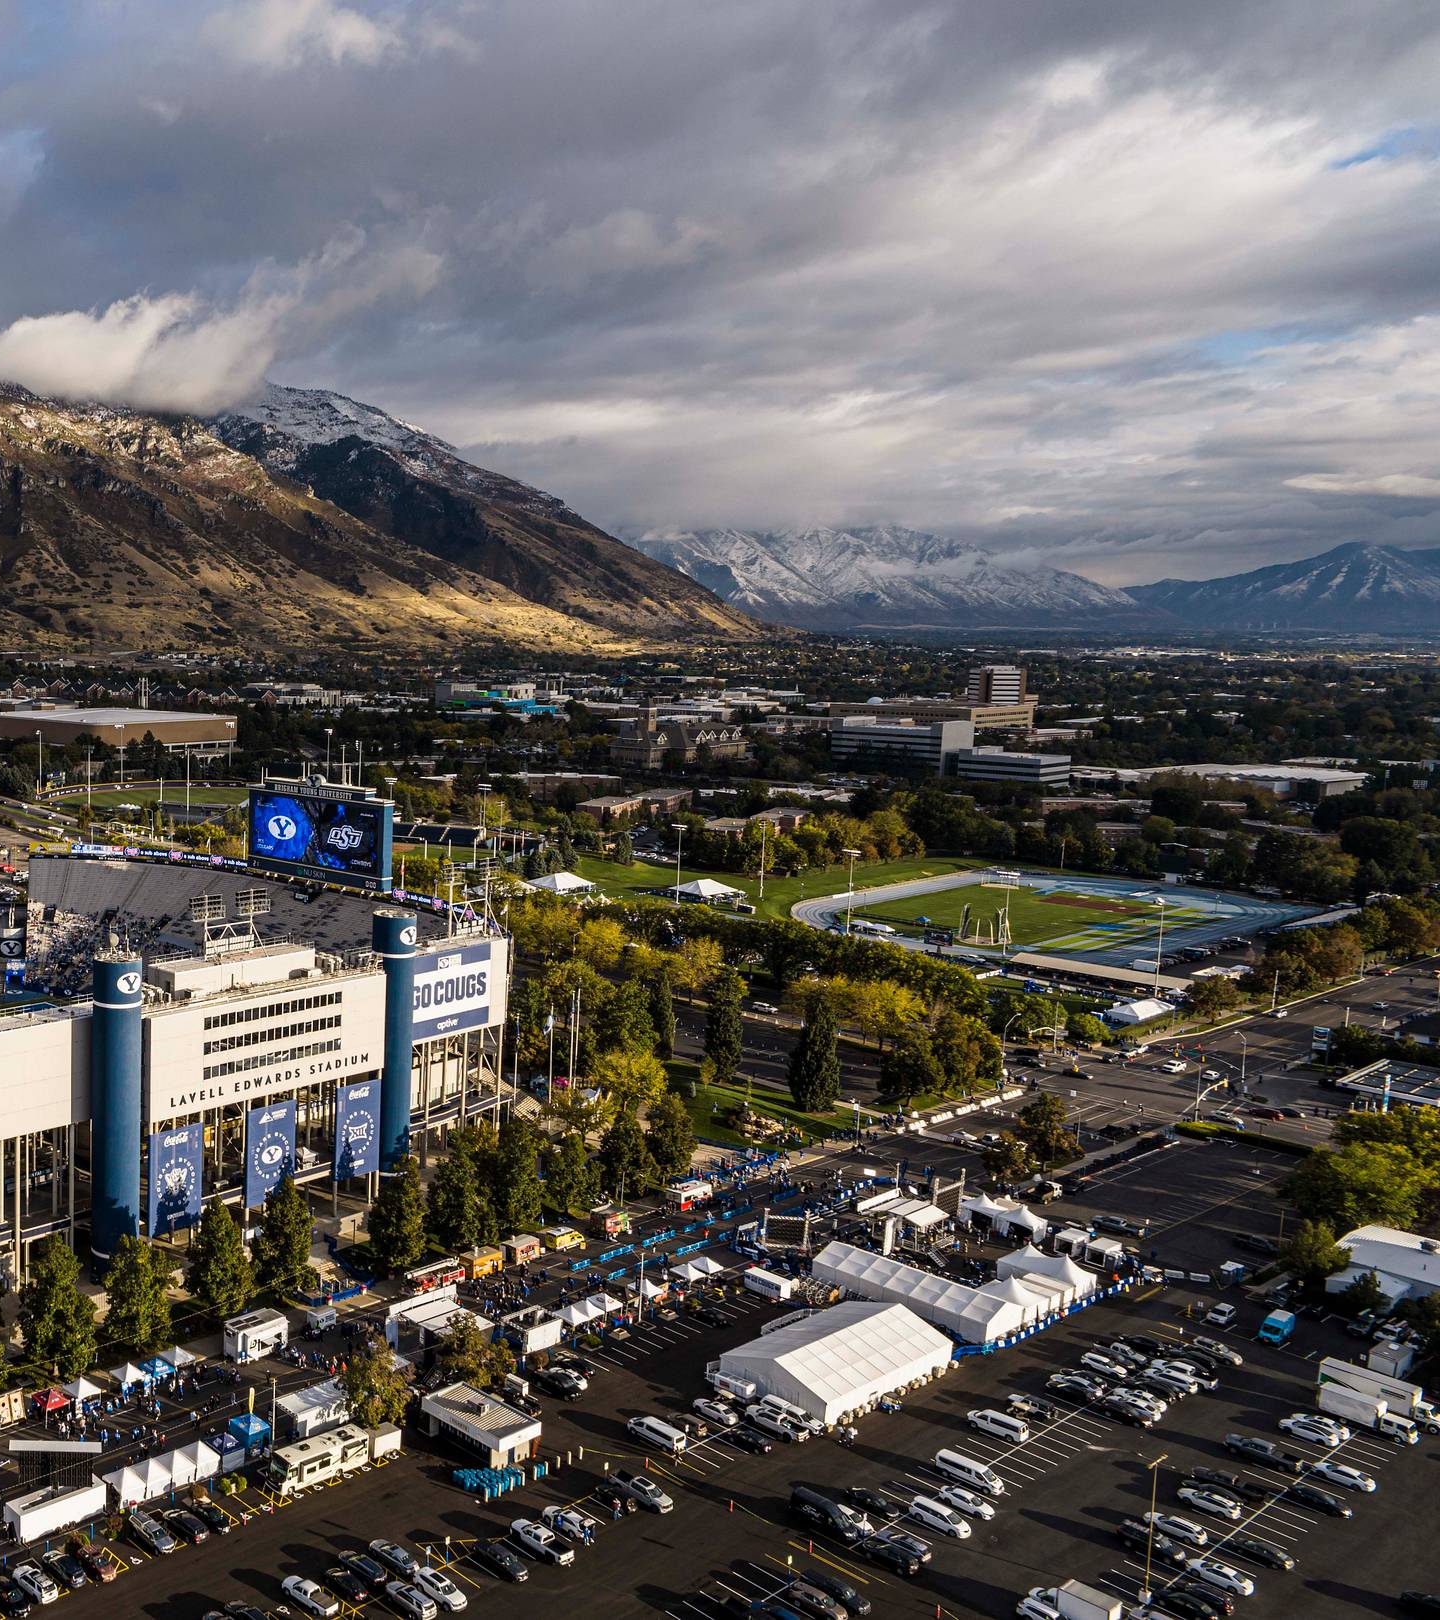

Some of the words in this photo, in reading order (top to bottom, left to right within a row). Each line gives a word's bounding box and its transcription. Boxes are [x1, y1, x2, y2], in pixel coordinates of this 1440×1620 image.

[274, 783, 299, 795] BRIGHAM
[300, 786, 318, 796] YOUNG
[318, 788, 353, 800] UNIVERSITY
[413, 983, 432, 1011] GO
[434, 971, 487, 1006] COUGS
[170, 1086, 225, 1108] LAVELL
[234, 1068, 301, 1093] EDWARDS
[309, 1052, 370, 1075] STADIUM
